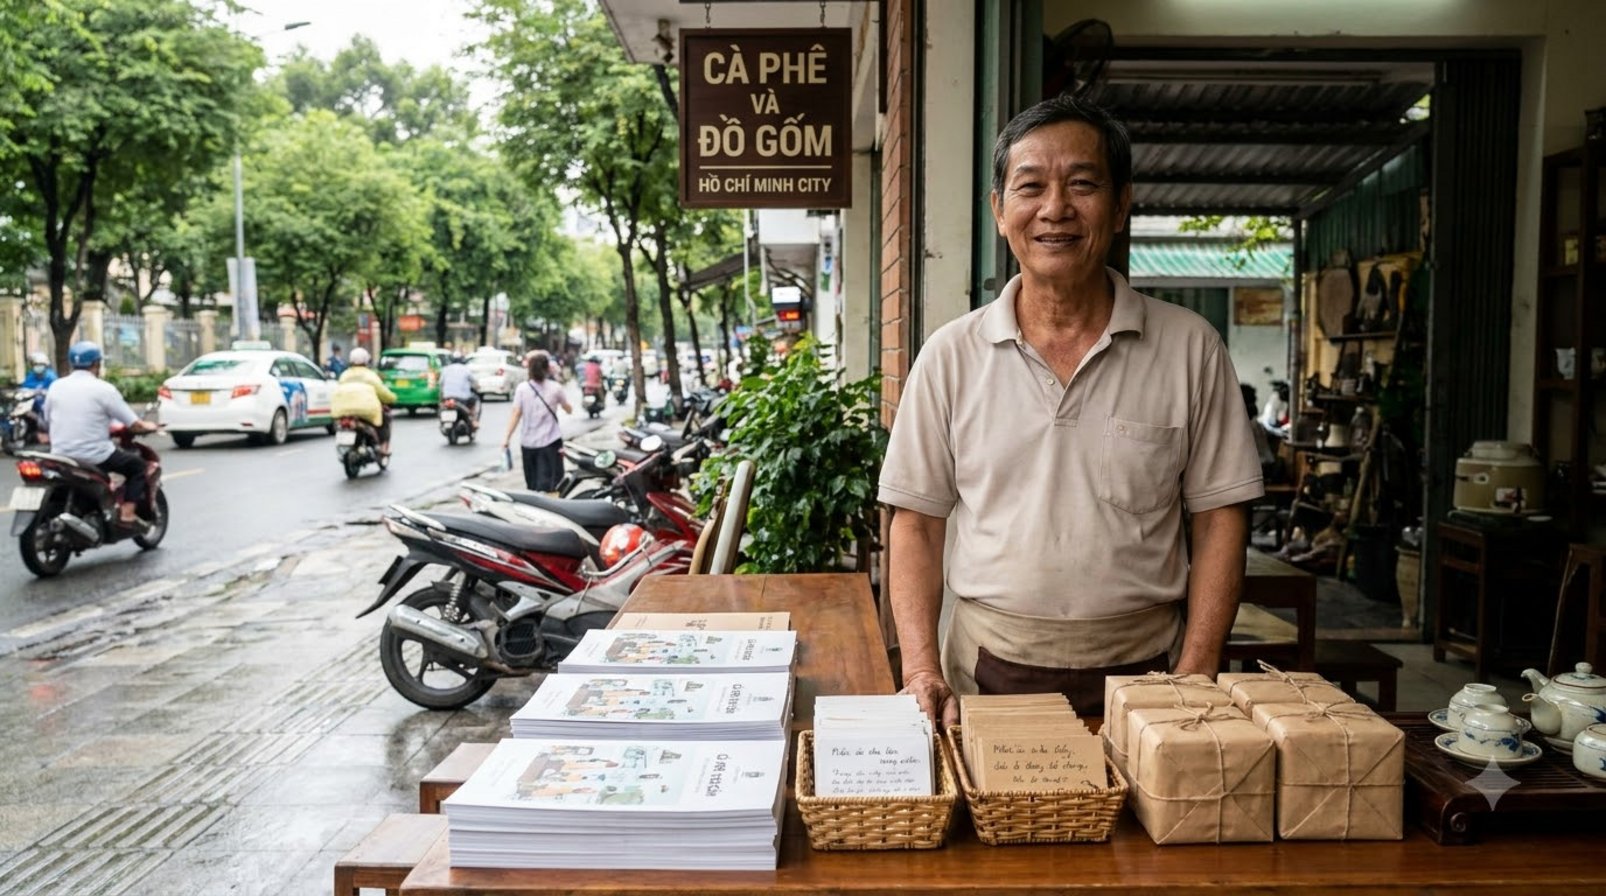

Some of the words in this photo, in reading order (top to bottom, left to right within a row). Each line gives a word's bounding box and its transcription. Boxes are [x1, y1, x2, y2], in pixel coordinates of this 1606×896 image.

[704, 44, 749, 84] CÀ
[759, 43, 827, 84] PHÊ
[750, 88, 780, 114] VÀ
[698, 114, 745, 157] ĐỒ
[755, 113, 832, 157] GỐM
[724, 174, 751, 192] CHÍ
[754, 178, 794, 192] MINH
[797, 178, 831, 192] CITY
